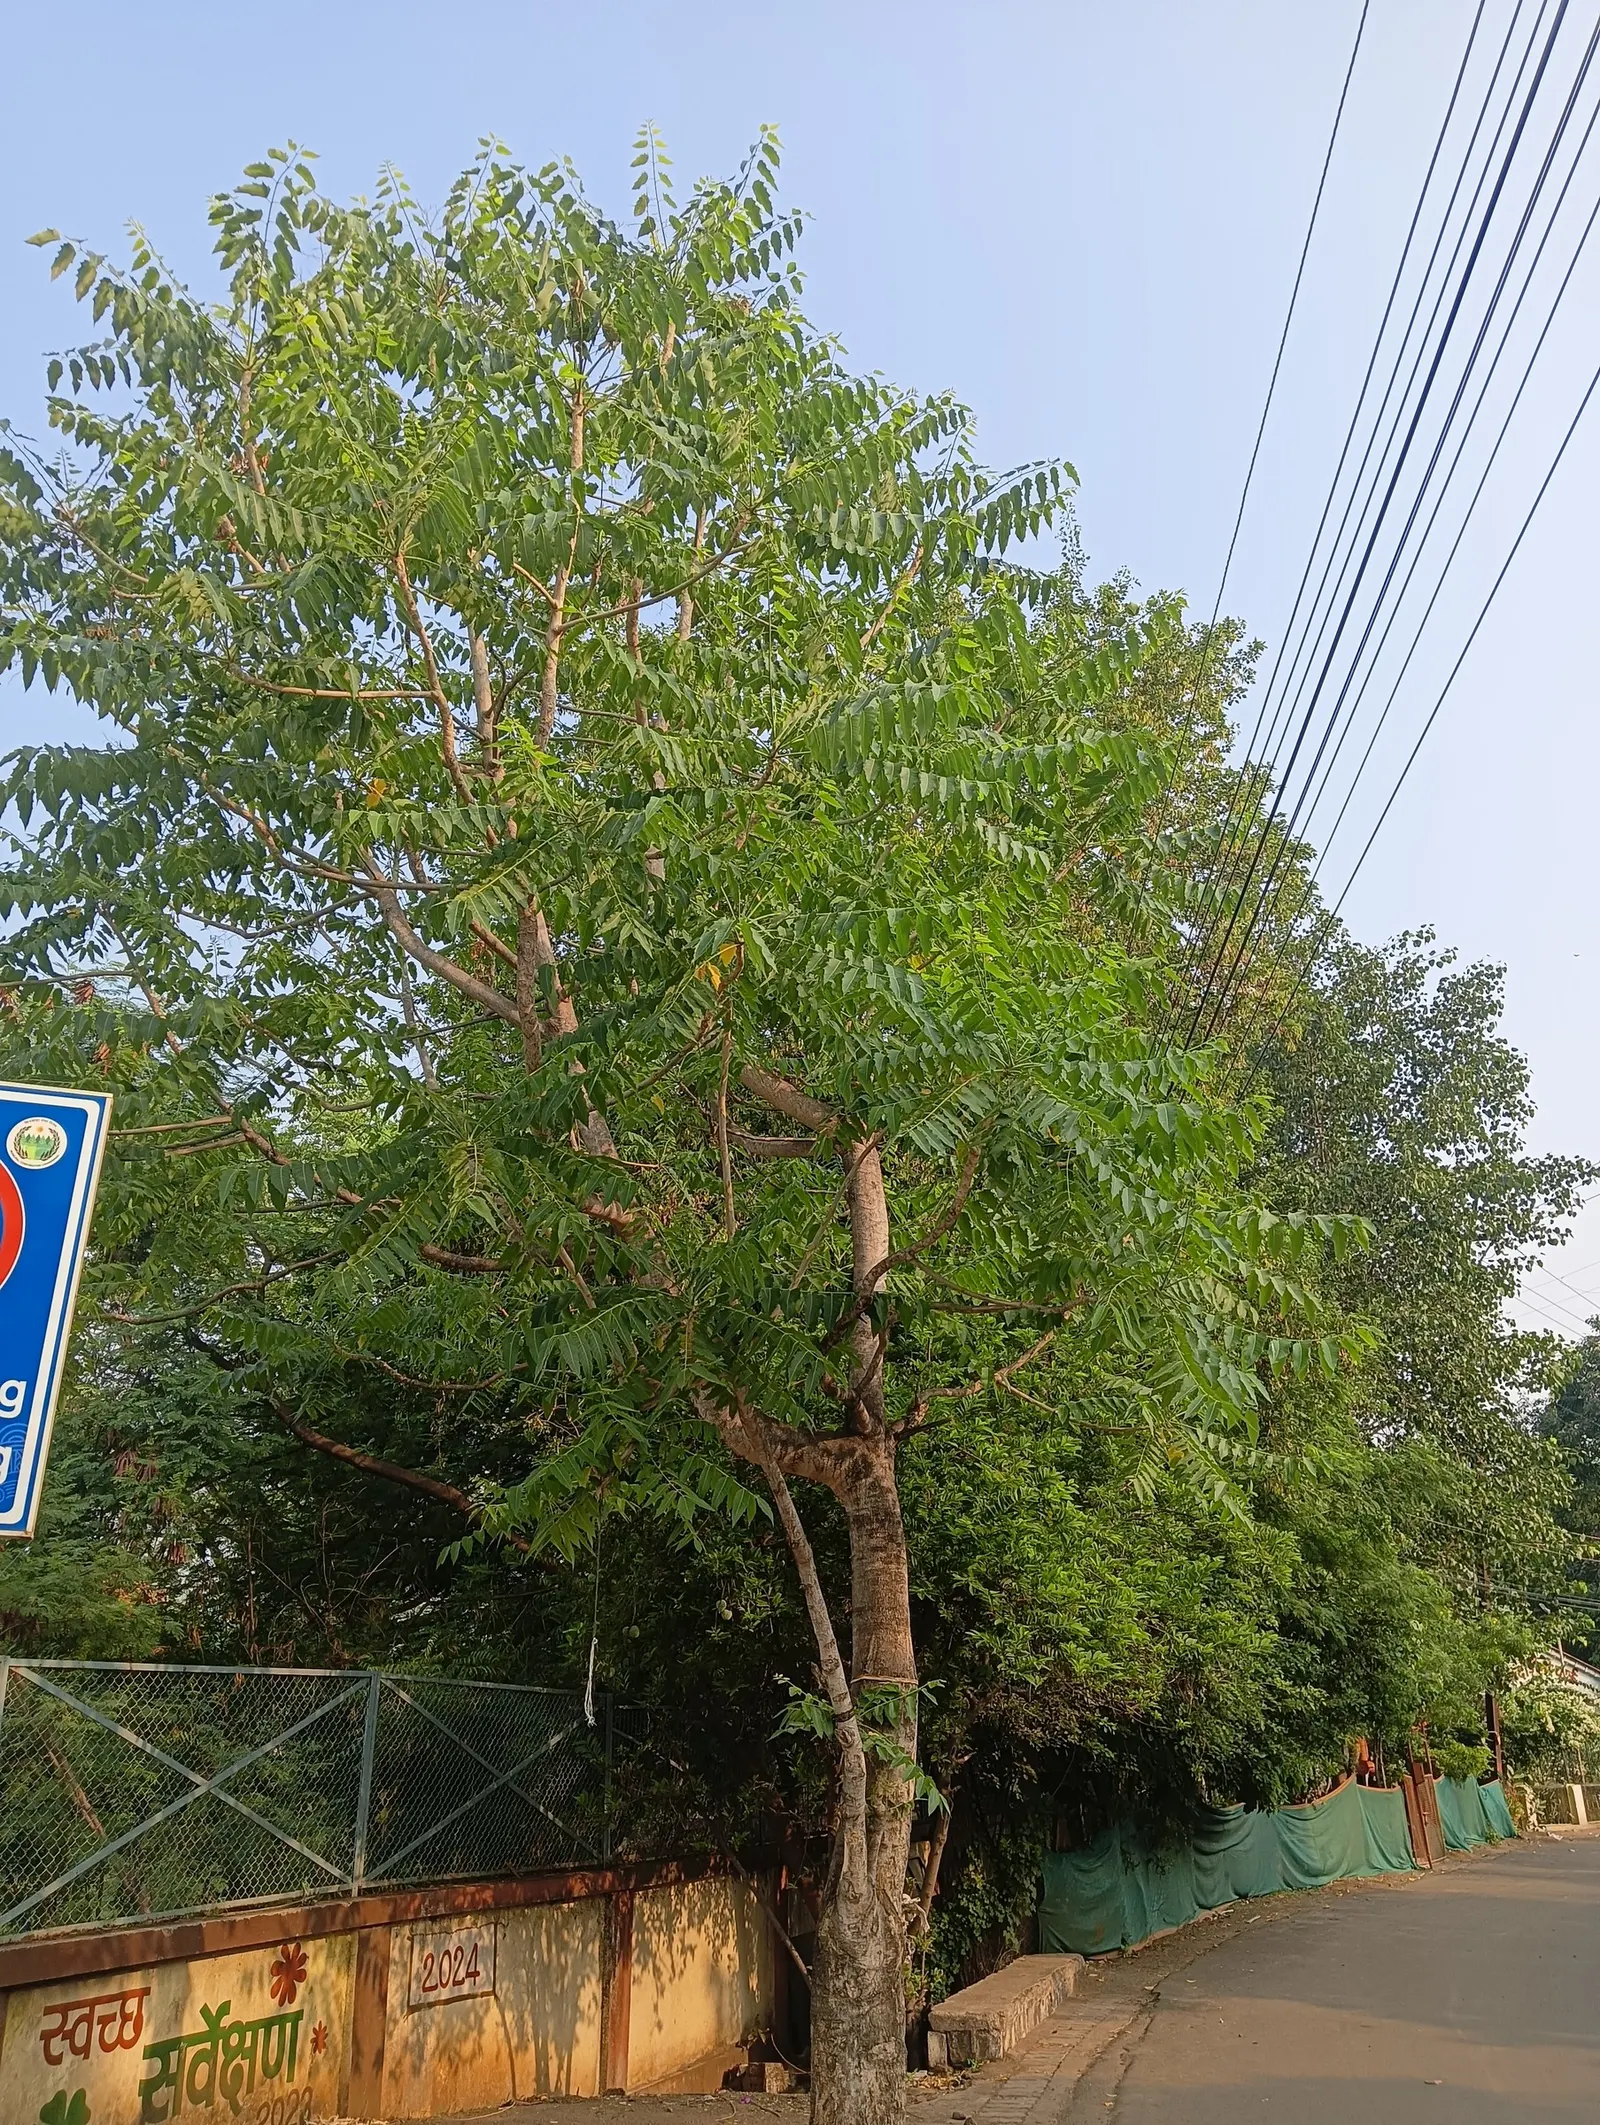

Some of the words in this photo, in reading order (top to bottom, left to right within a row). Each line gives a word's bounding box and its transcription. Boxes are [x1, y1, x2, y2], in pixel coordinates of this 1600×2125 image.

[421, 1942, 480, 1993] 2024
[39, 1986, 151, 2066] स्वच्छ
[137, 1999, 304, 2123] सर्वेक्षण
